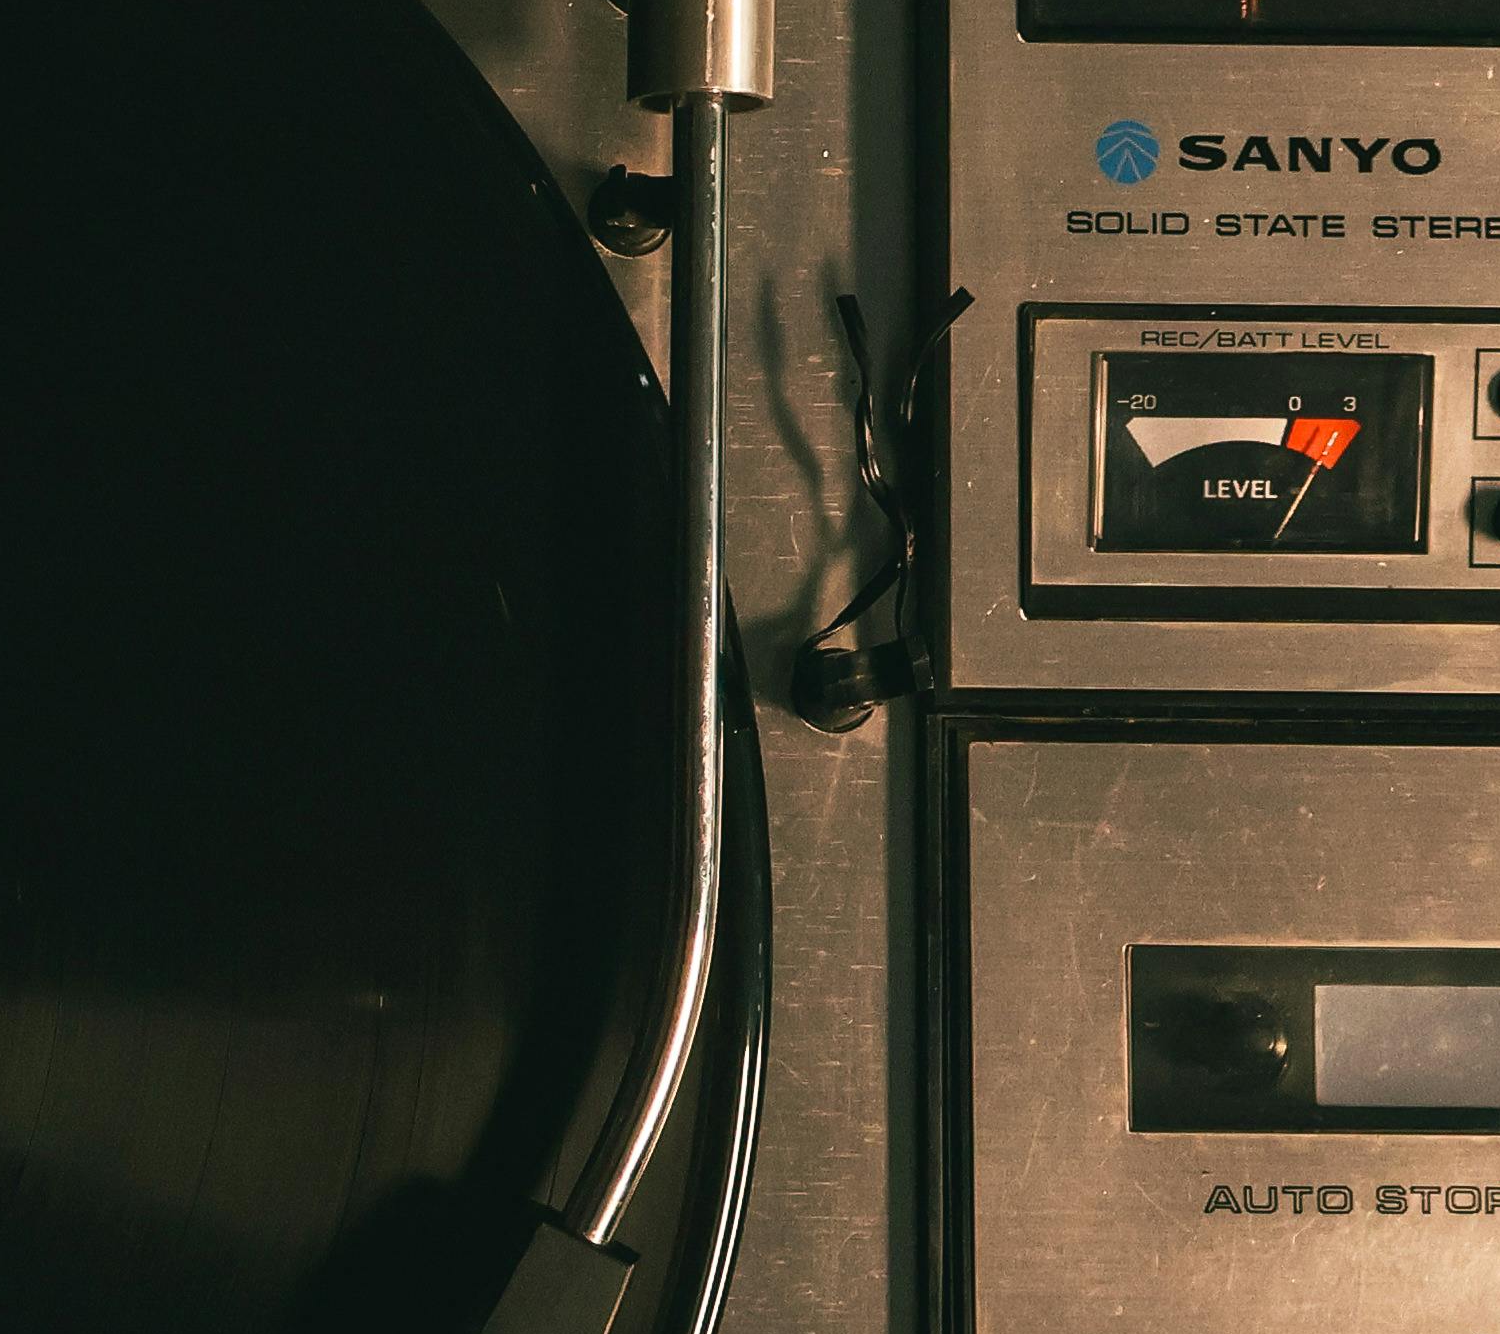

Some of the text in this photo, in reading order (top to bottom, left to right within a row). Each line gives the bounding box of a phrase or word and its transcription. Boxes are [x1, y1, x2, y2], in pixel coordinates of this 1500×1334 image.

[1177, 134, 1443, 176] SANYO
[1066, 210, 1191, 236] SOLID
[1214, 212, 1346, 238] STATE
[1140, 329, 1390, 351] REC/BATT LEVEL
[1116, 394, 1357, 412] -20 0 3
[1203, 478, 1279, 501] LEVEL
[1203, 1184, 1354, 1214] AUTO
